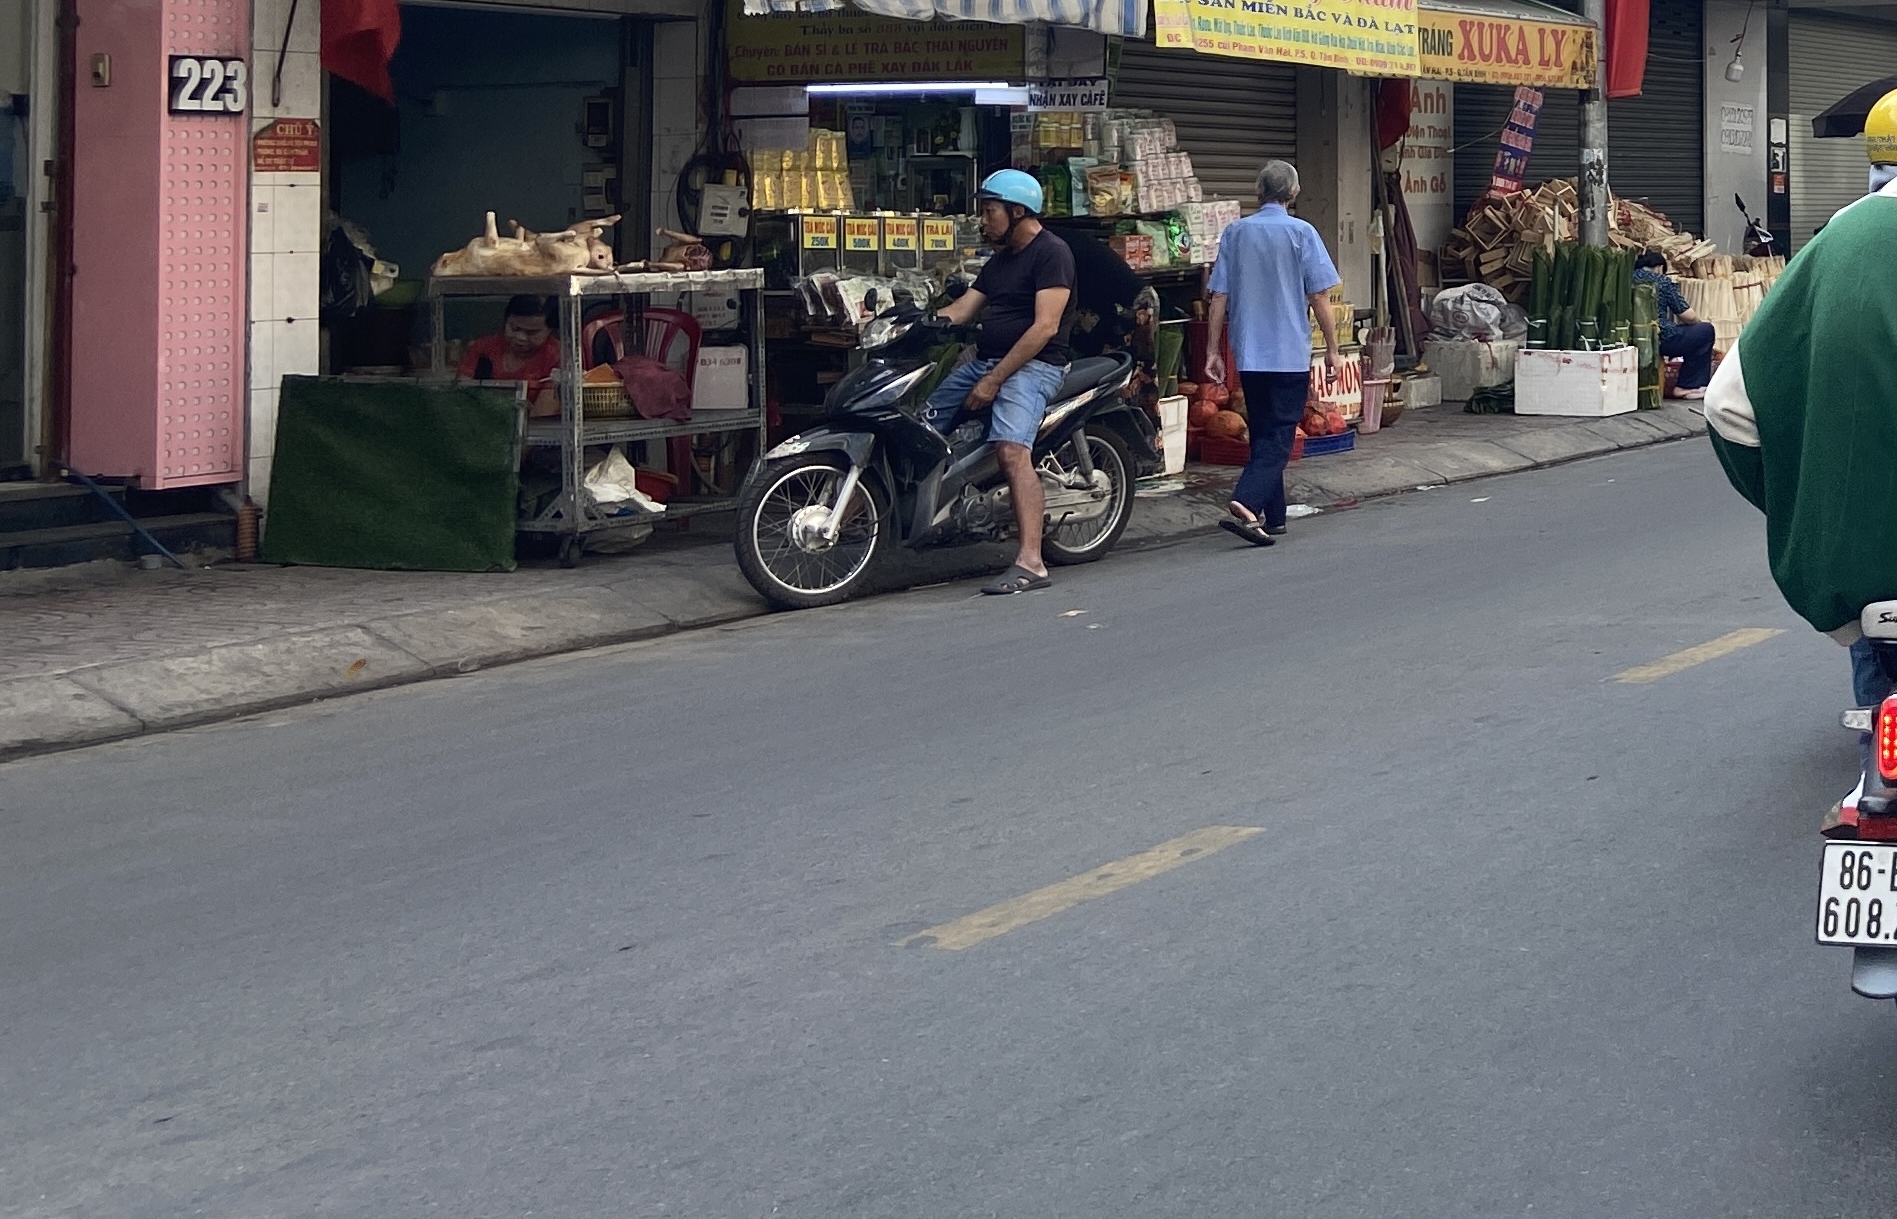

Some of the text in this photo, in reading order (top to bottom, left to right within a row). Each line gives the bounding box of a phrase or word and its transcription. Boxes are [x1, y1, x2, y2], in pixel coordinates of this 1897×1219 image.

[1293, 3, 1327, 22] BẮC
[1384, 21, 1415, 37] LẠT
[1458, 20, 1531, 66] XUKA
[1537, 28, 1567, 68] LY
[174, 57, 249, 112] 223
[1029, 90, 1057, 108] NHẬN
[1058, 93, 1078, 106] XAY
